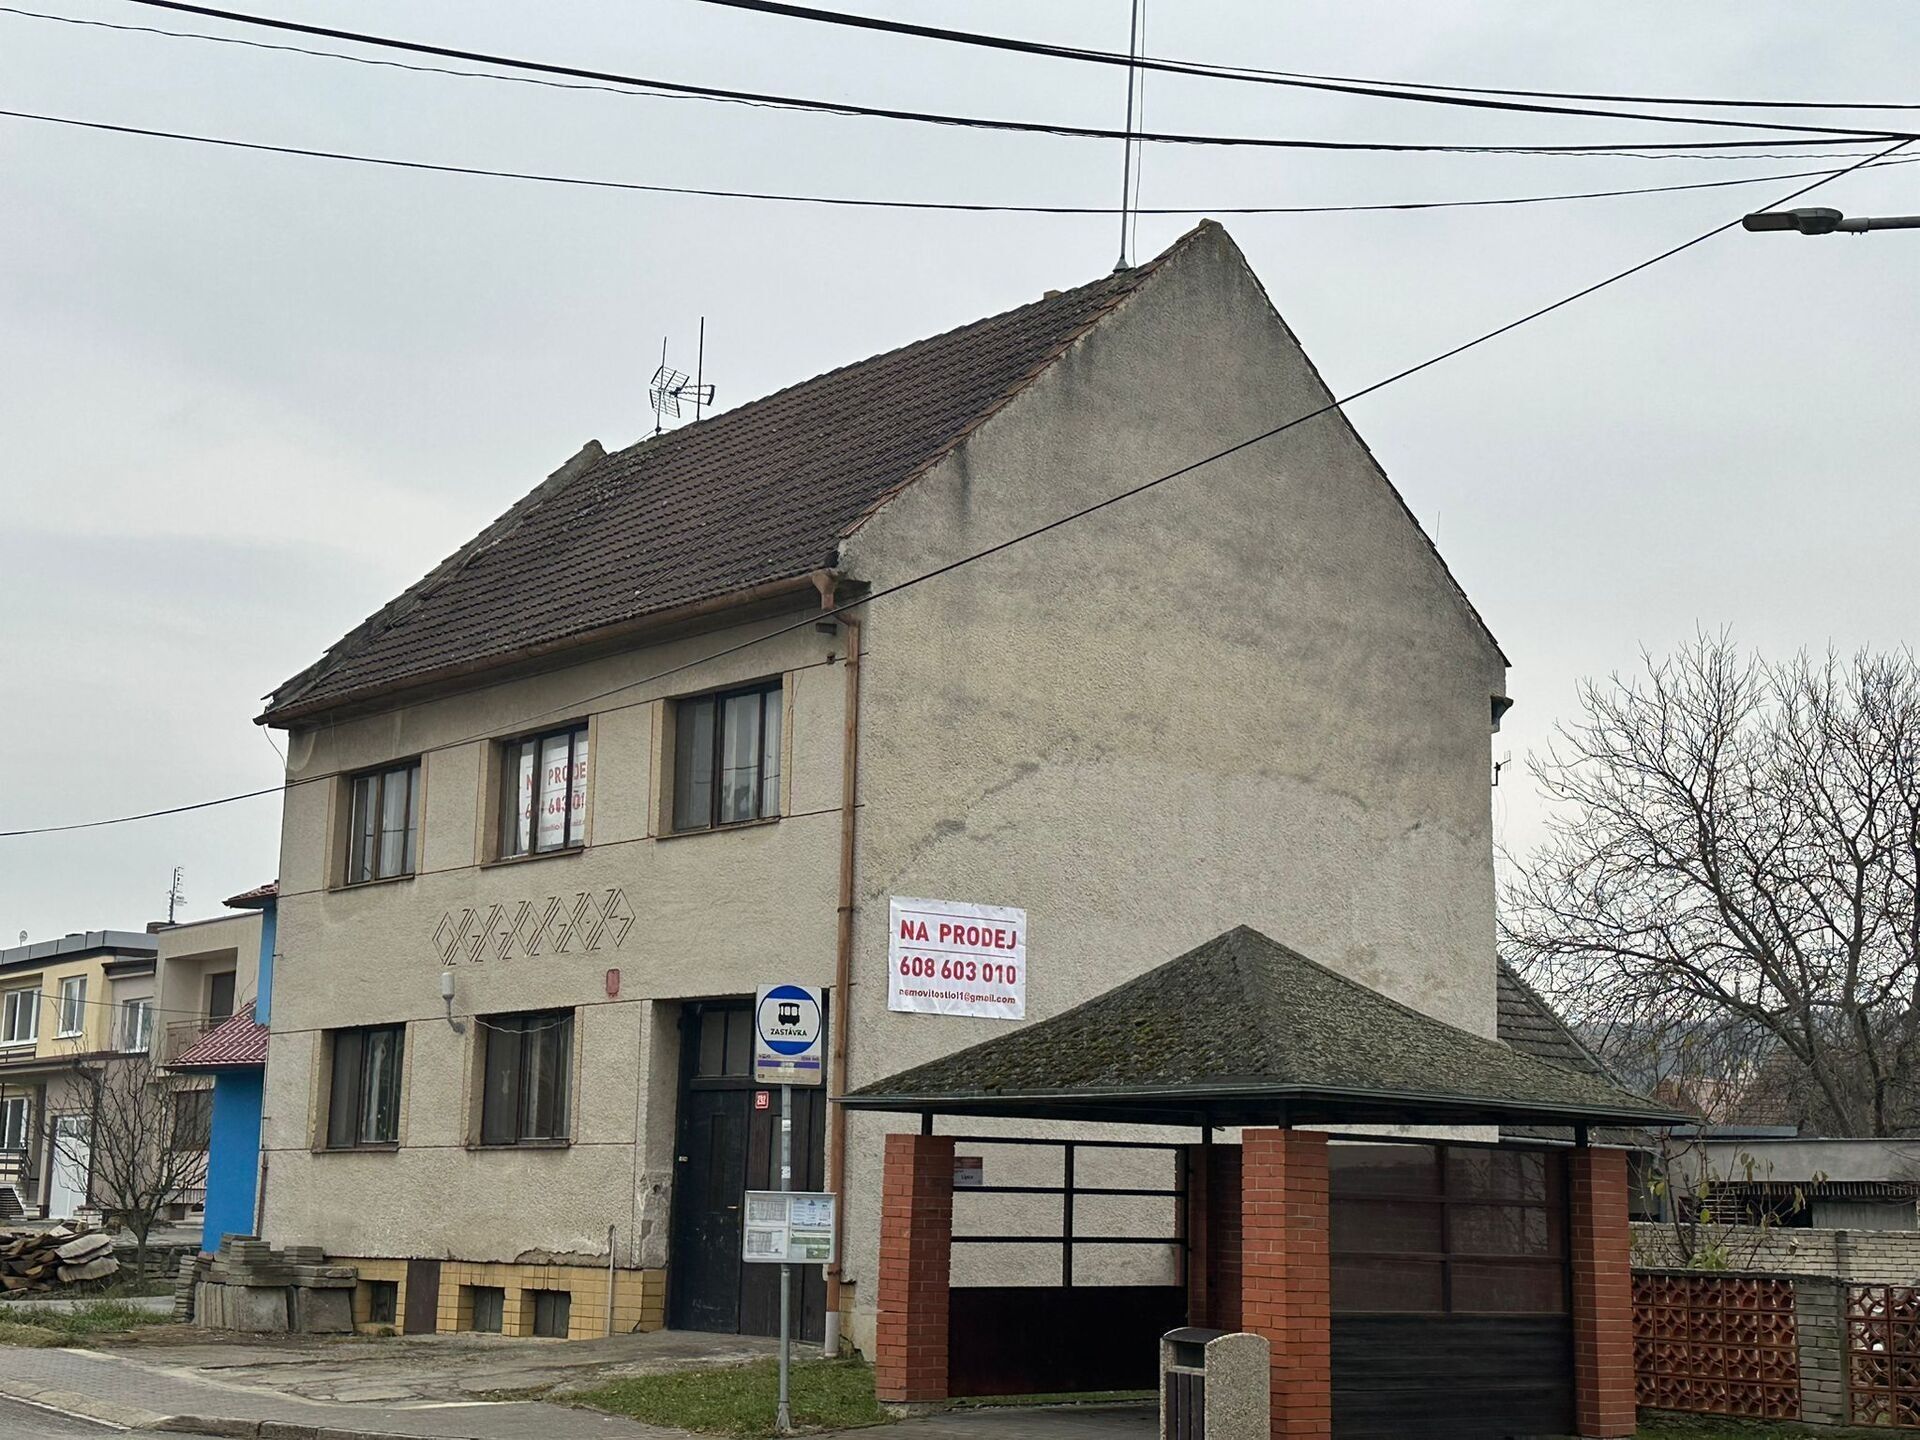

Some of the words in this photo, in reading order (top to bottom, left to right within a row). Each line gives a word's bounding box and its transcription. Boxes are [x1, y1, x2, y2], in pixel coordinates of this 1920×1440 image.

[548, 762, 586, 786] PRODE
[900, 919, 929, 942] NA
[939, 923, 1017, 950] PRODEJ
[899, 956, 936, 978] 608
[940, 959, 977, 981] 603
[982, 963, 1017, 985] 010
[770, 1026, 808, 1037] ZASTÁVKA
